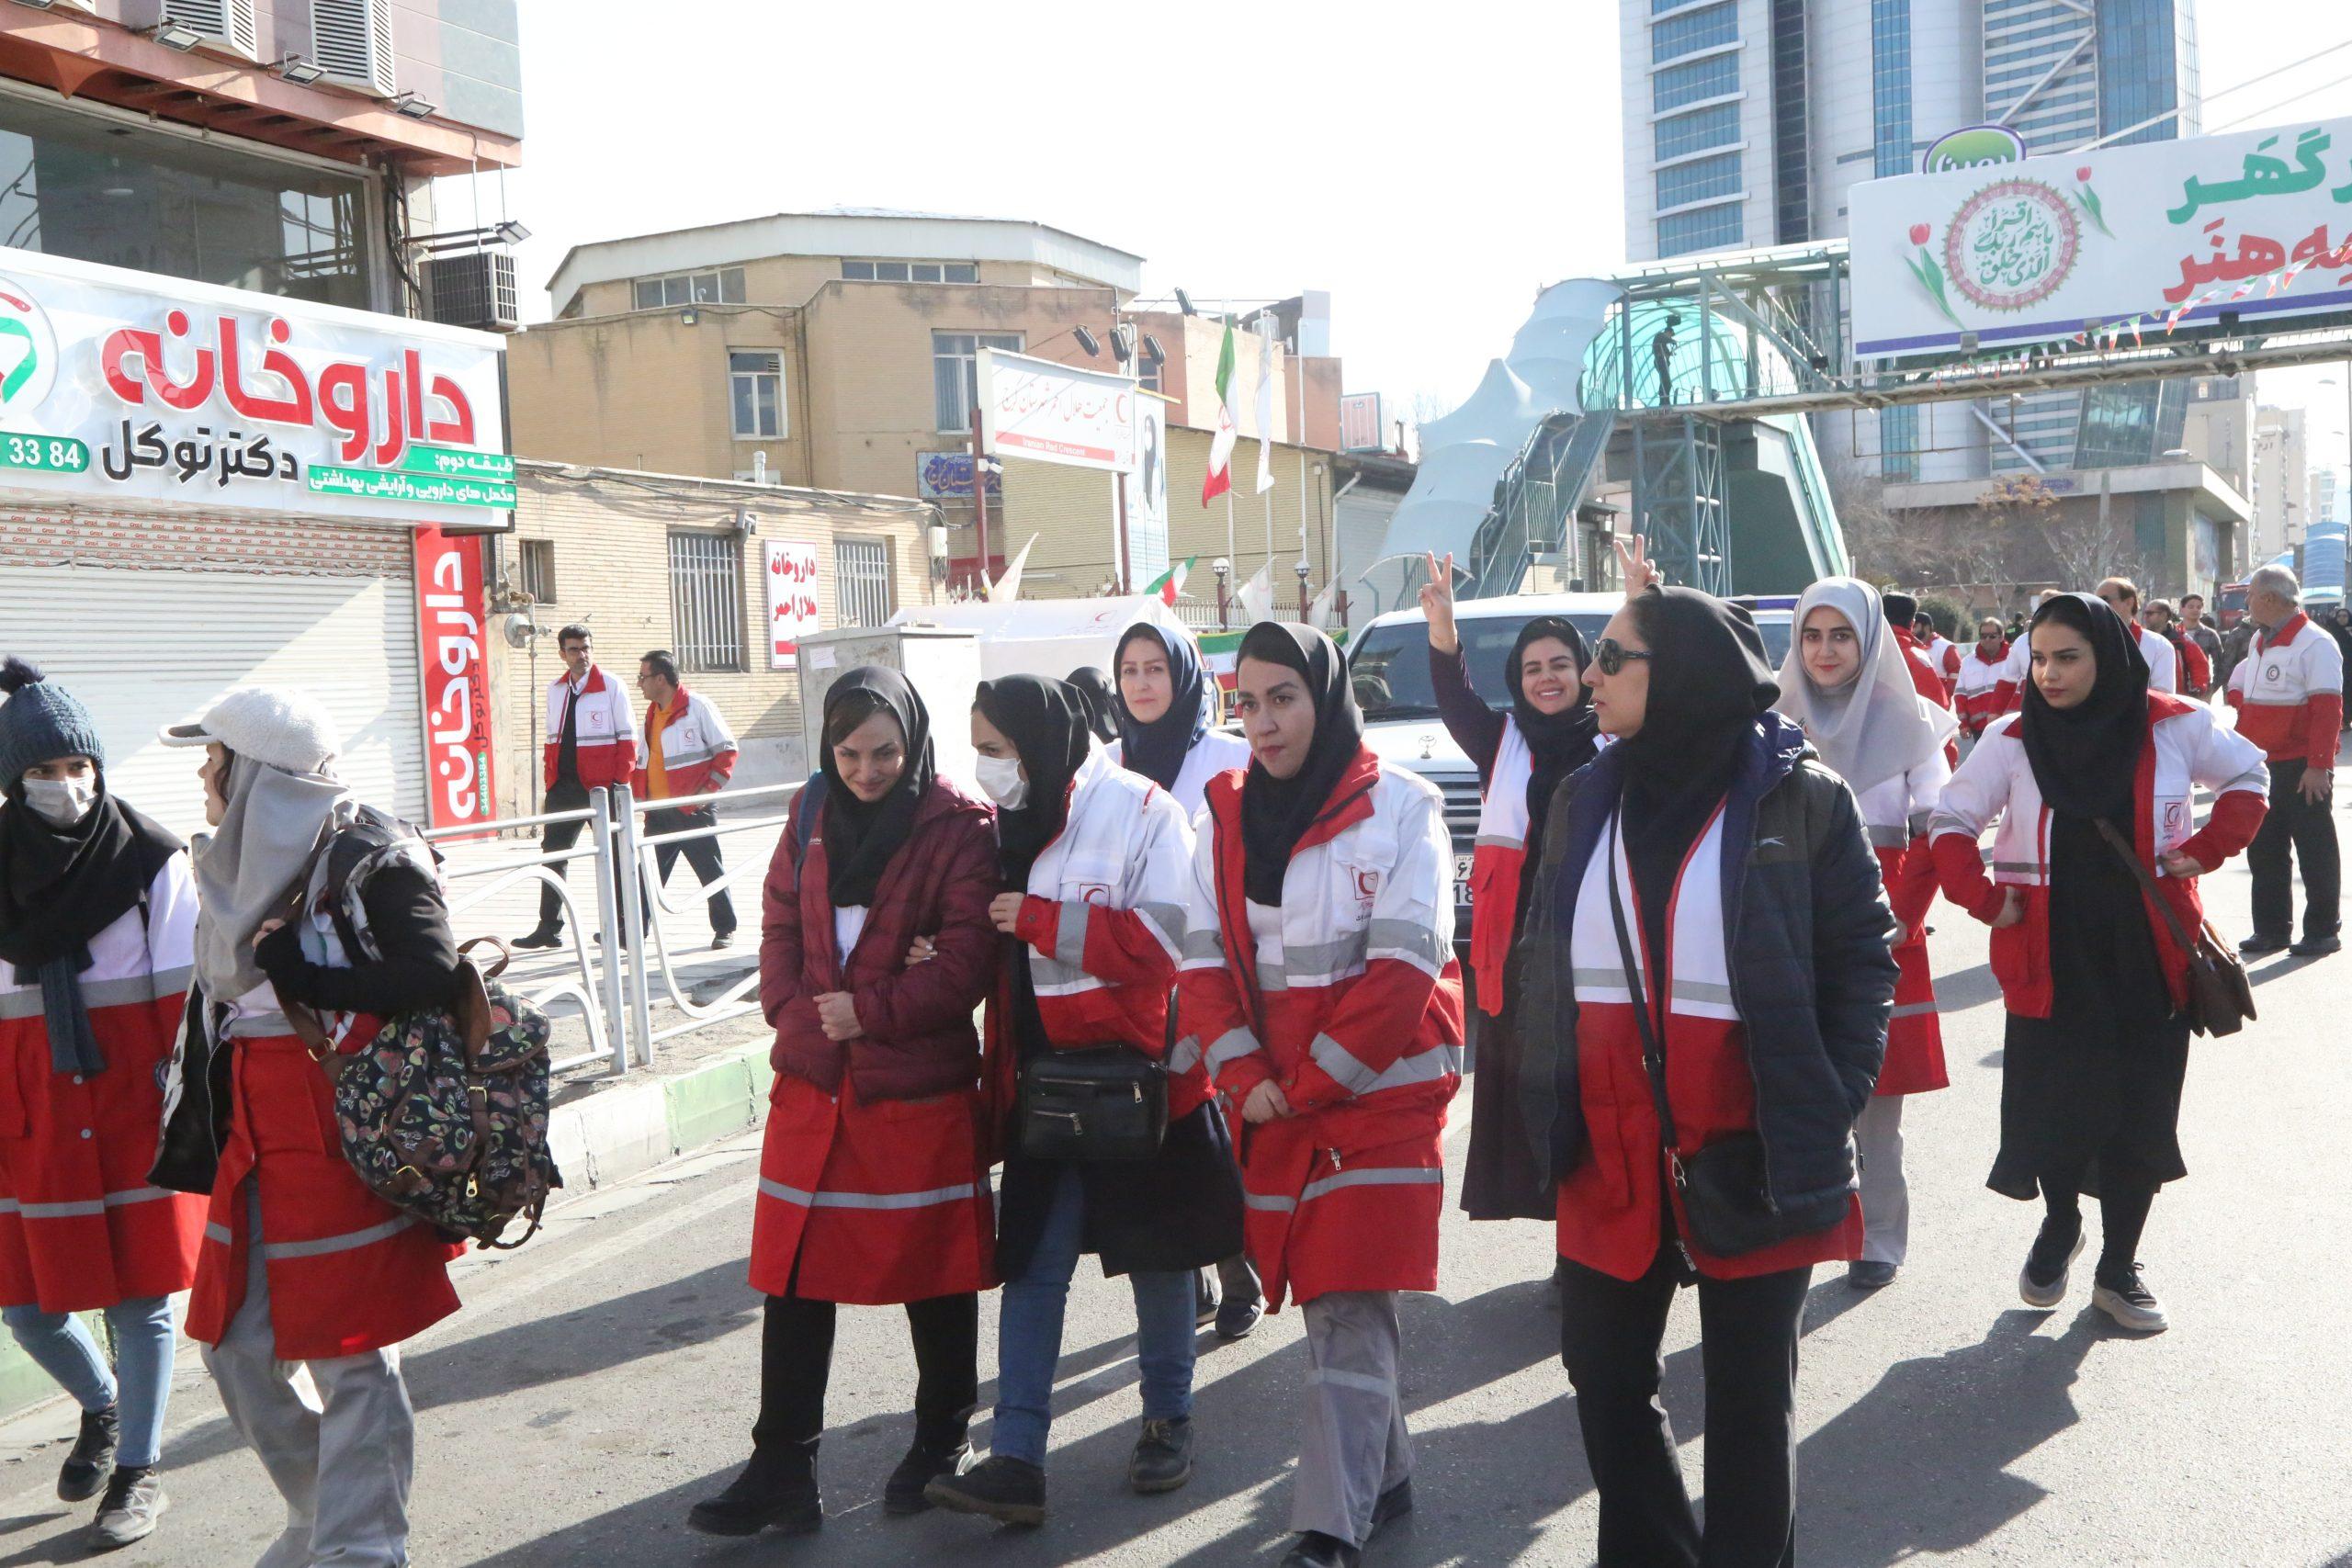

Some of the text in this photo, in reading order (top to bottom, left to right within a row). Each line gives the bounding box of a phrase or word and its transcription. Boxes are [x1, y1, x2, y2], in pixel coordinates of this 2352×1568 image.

[101, 309, 475, 467] داروخانه
[8, 437, 81, 468] 33 84
[102, 419, 299, 488] دکتر توکل
[1023, 436, 1086, 456] Iranian Red Crescent
[434, 453, 514, 477] طبقه دوم:
[310, 469, 365, 494] بهداشتی
[416, 482, 455, 502] دارویی
[457, 483, 481, 502] های
[482, 486, 515, 502] مکمل
[772, 551, 816, 583] داروخانه
[773, 592, 817, 623] هلال احمر
[424, 551, 480, 818] داروخانه
[469, 662, 489, 749] دکتر توکل
[478, 756, 489, 812] 34403384
